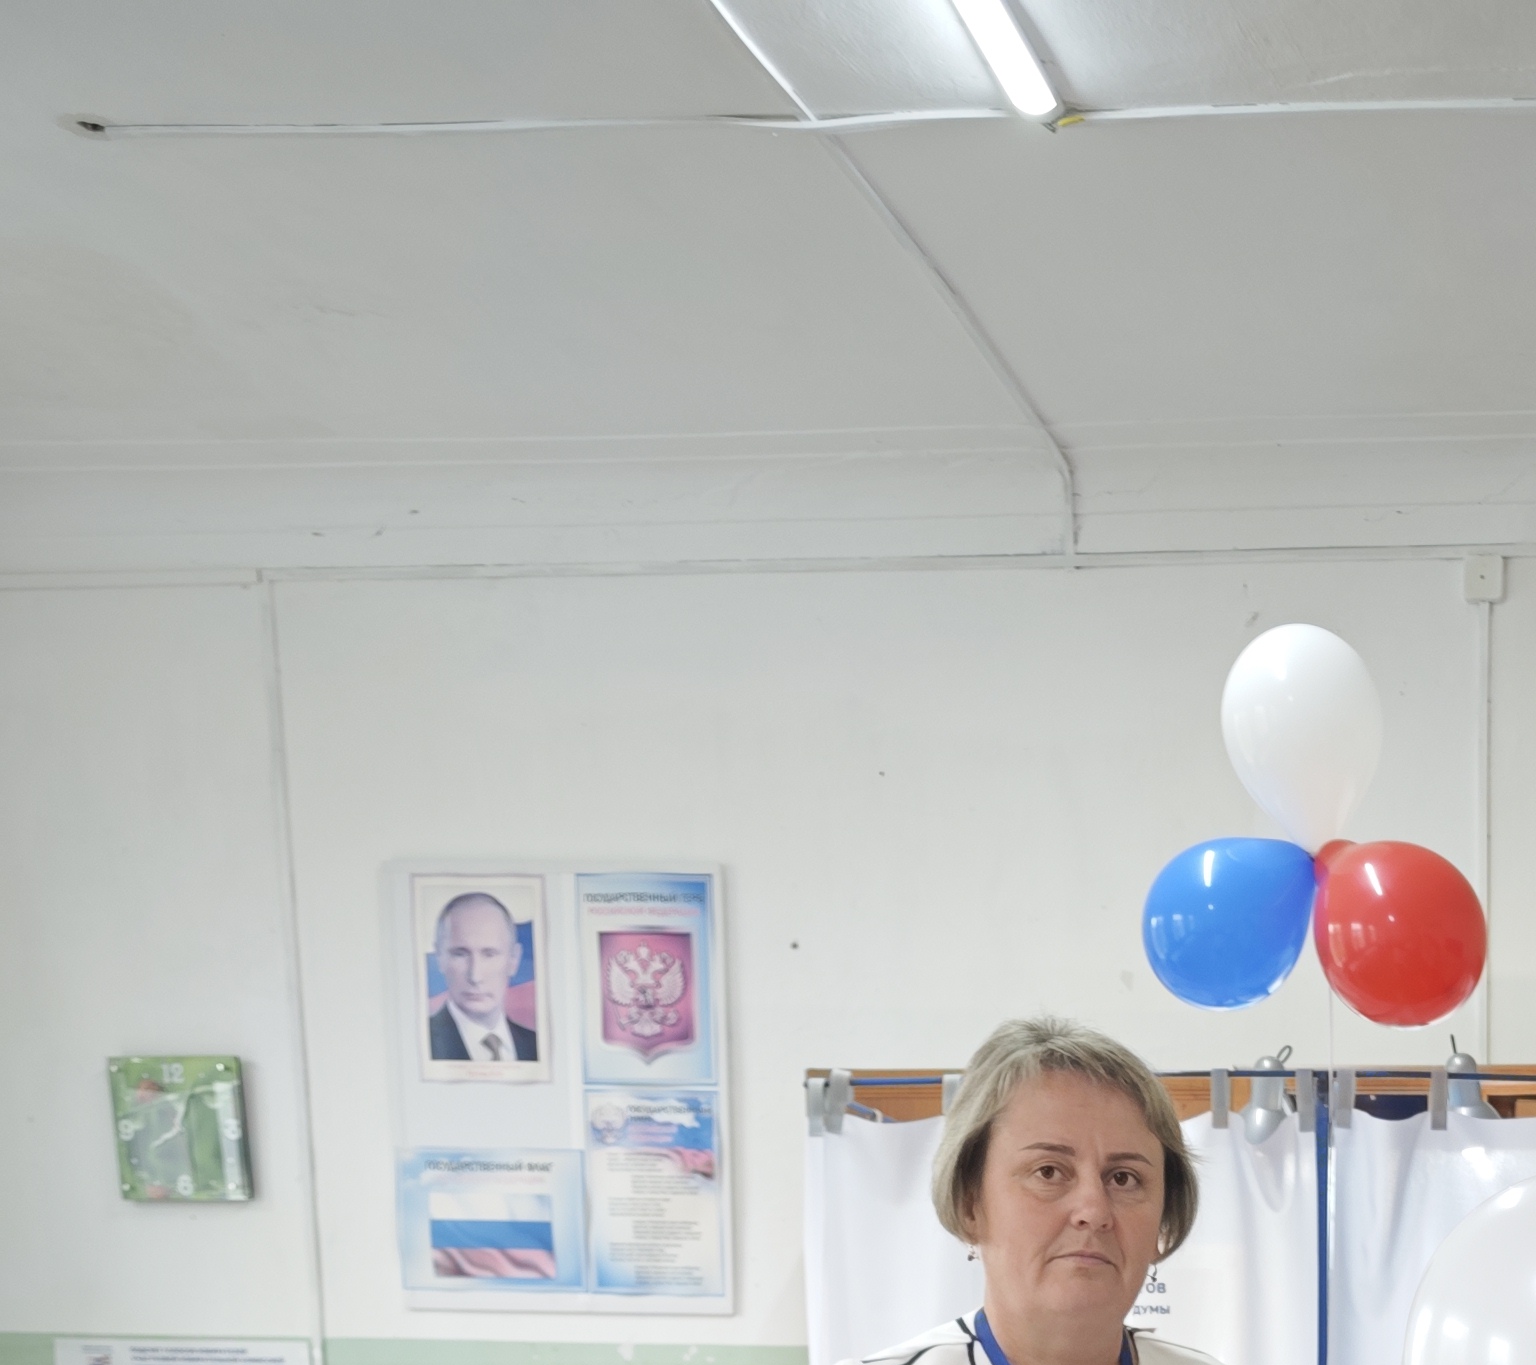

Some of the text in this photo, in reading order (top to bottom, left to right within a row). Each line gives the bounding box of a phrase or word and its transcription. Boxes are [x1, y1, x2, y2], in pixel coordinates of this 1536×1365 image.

[161, 1062, 185, 1083] 12
[118, 1119, 136, 1141] 9
[1133, 1304, 1171, 1315] ДУМЫ
